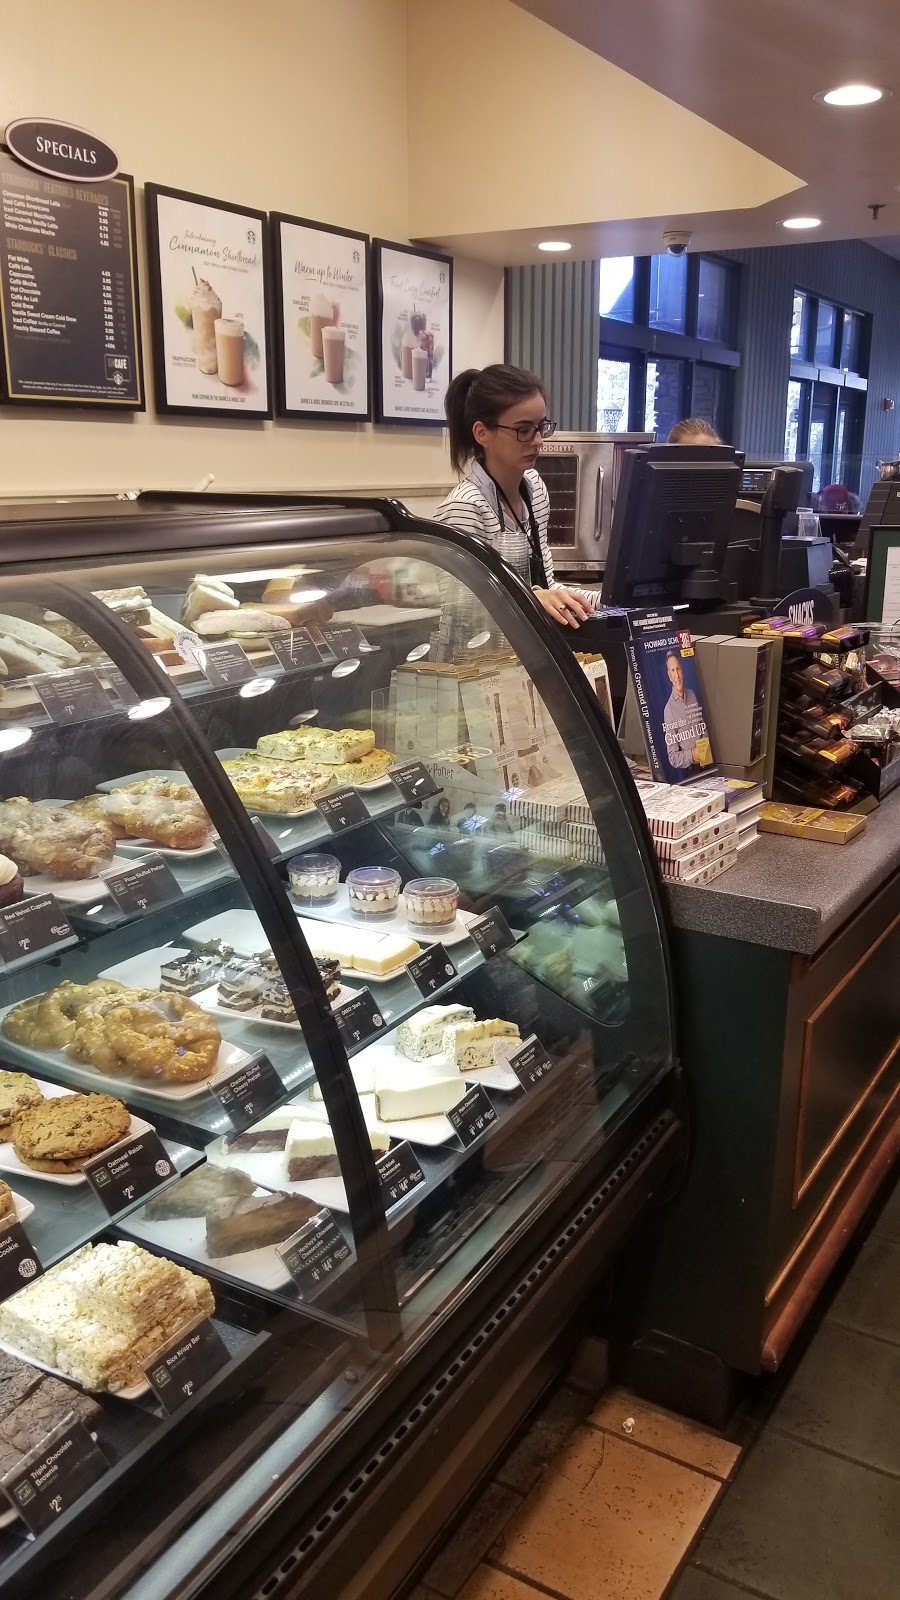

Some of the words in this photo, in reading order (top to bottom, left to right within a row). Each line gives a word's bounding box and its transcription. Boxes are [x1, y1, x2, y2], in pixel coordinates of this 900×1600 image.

[36, 136, 97, 164] SPECIALS
[75, 188, 109, 206] BEVERAGES
[184, 230, 216, 247] Introducing
[48, 245, 77, 260] CLASSICS
[169, 235, 221, 258] Cinnamon
[222, 246, 257, 267] Shortbread
[294, 259, 316, 275] Warm
[333, 267, 353, 283] Winter
[539, 445, 571, 453] LODGETT
[788, 600, 815, 625] SNACKS
[629, 645, 638, 662] From
[644, 638, 668, 650] HOWARD
[634, 672, 647, 704] Ground
[641, 703, 651, 718] UP
[645, 719, 654, 745] HOWARD
[662, 722, 678, 732] From
[677, 718, 687, 728] the
[664, 726, 696, 746] Ground
[695, 722, 707, 736] UP
[650, 744, 660, 769] SCHULTZ
[433, 762, 454, 779] Potter
[135, 869, 152, 879] Stuffed
[150, 863, 165, 873] Pretzel
[15, 907, 31, 917] Velvet
[30, 900, 52, 911] Cupcake
[229, 1073, 247, 1088] Cheddar
[245, 1064, 261, 1077] Stuffed
[233, 1080, 249, 1094] Cheesy
[247, 1071, 262, 1084] Pretzel
[107, 1151, 129, 1168] Oatmeal
[127, 1143, 144, 1156] Raisin
[110, 1160, 130, 1175] Cookie
[381, 1162, 401, 1179] Cheesecake
[316, 1222, 334, 1238] Chocolate
[301, 1239, 324, 1260] Cheesecake
[165, 1354, 178, 1366] Rice
[176, 1341, 193, 1357] Krispy
[190, 1334, 201, 1345] Bar
[30, 1462, 48, 1480] Triple
[45, 1439, 73, 1466] Chocolate
[34, 1464, 59, 1487] Brownie
